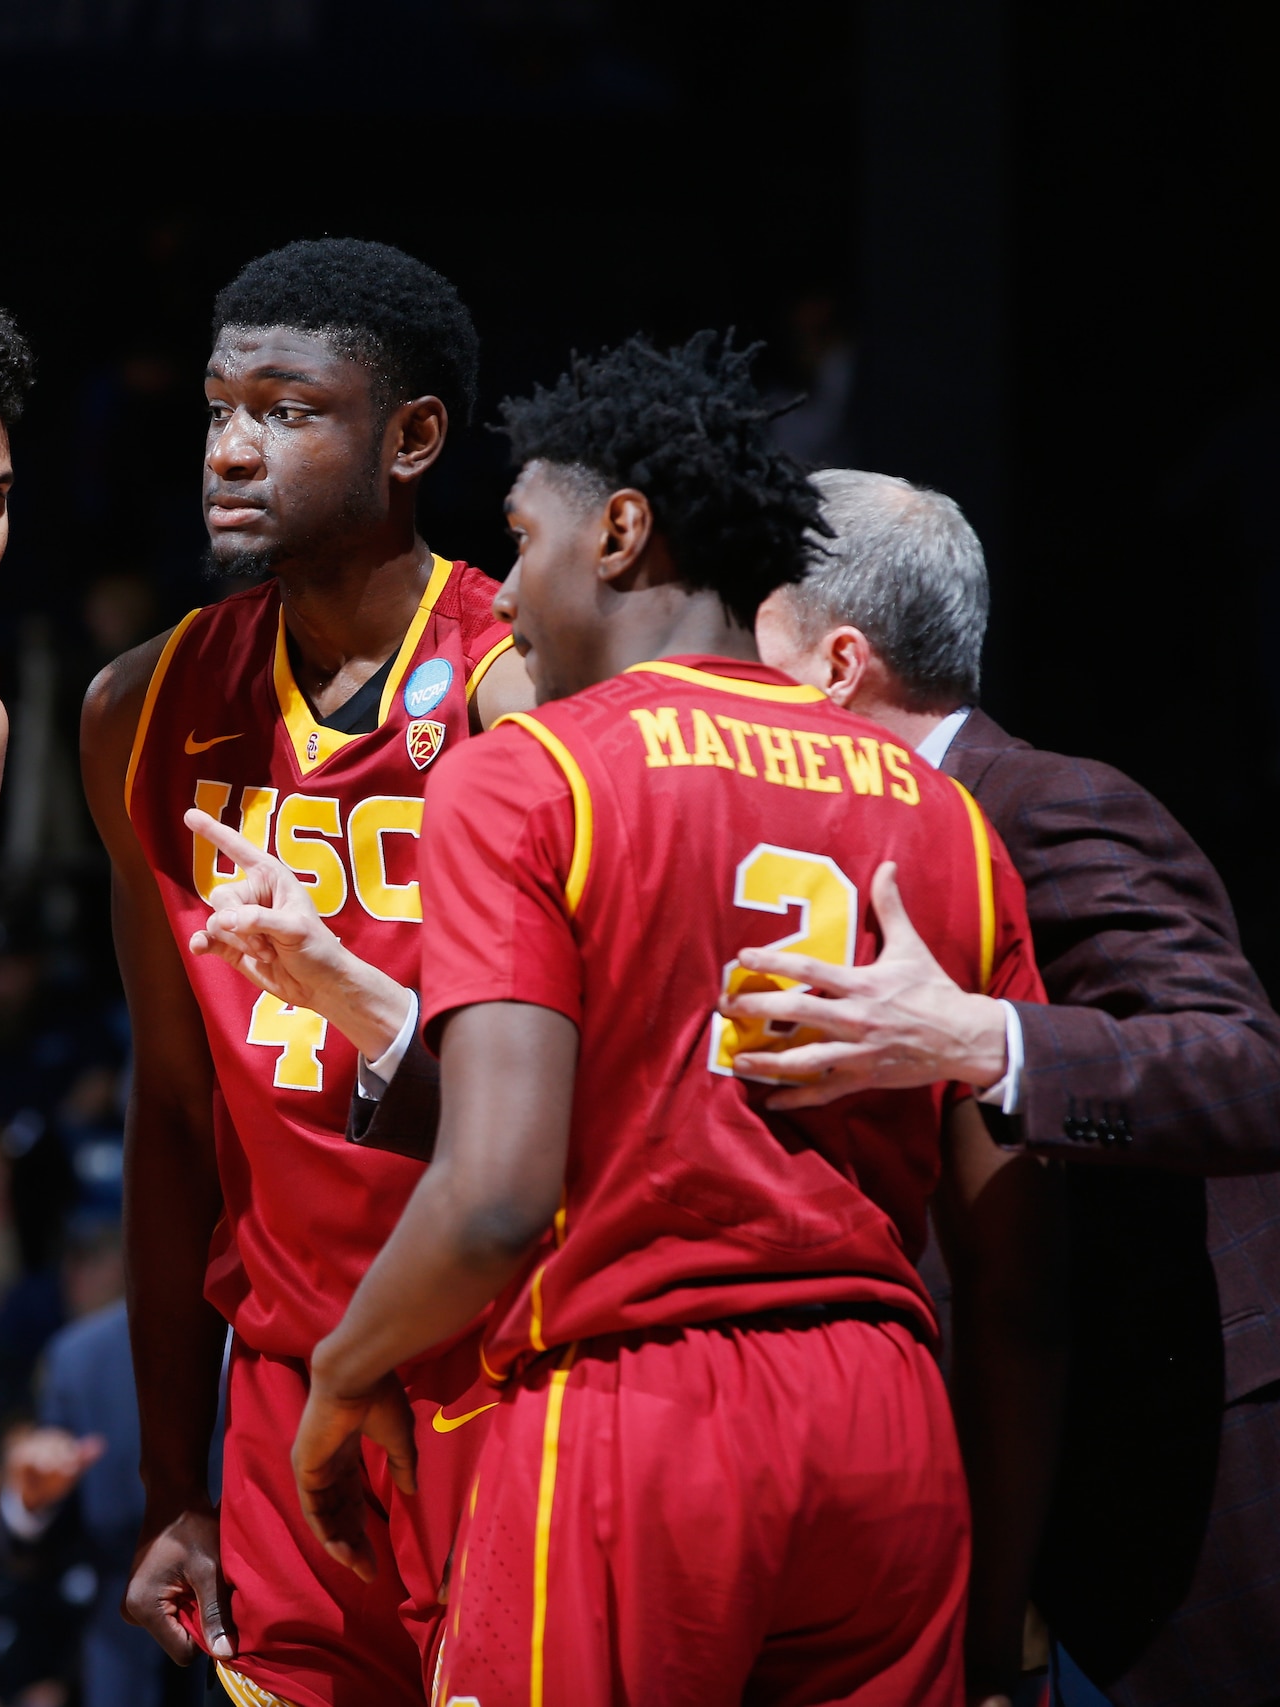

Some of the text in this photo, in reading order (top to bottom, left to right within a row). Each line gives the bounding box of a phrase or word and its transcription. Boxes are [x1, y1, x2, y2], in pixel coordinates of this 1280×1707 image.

[411, 679, 448, 706] NCAA
[412, 740, 432, 759] 12
[629, 707, 920, 806] MATHEWS
[193, 779, 425, 923] USC
[246, 937, 341, 1091] 4
[707, 842, 858, 1086] 2
